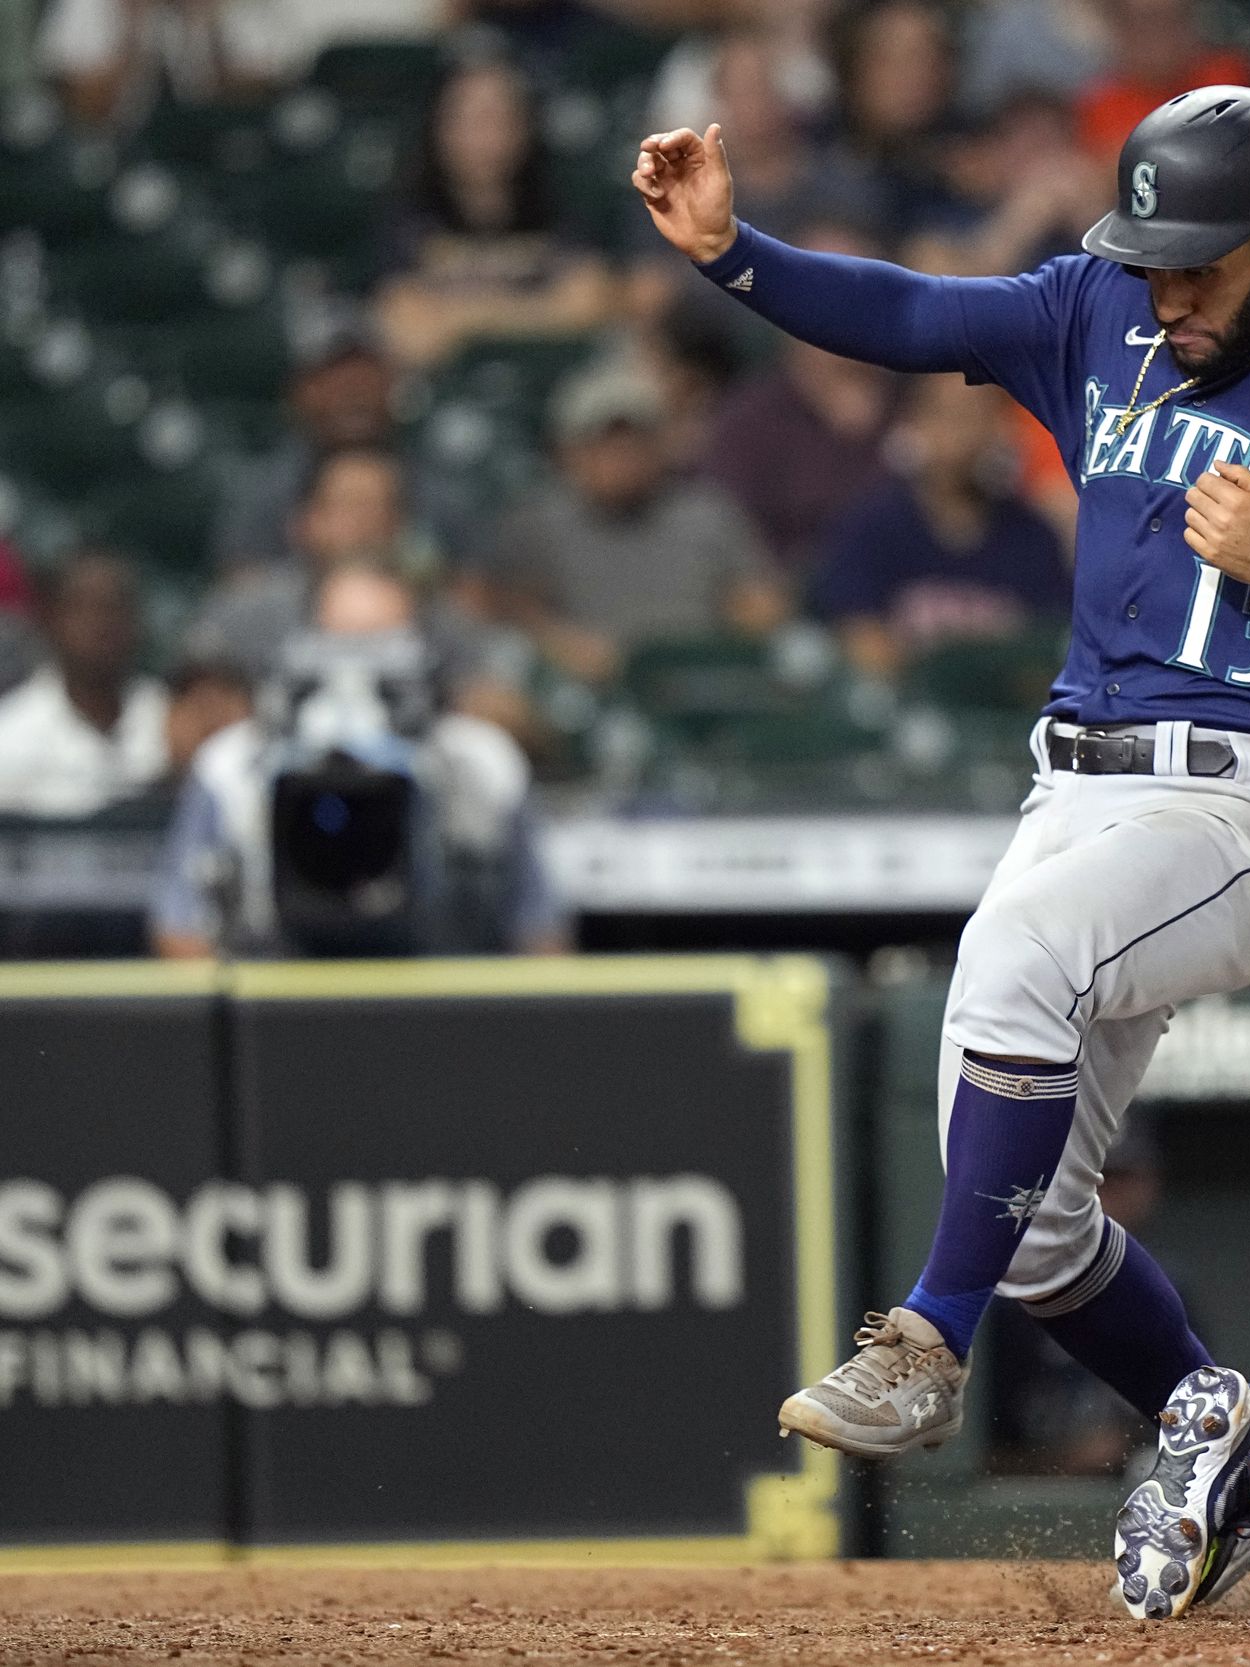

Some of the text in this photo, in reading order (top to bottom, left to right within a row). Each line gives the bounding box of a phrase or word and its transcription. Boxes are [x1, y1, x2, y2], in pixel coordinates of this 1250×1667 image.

[1132, 161, 1158, 219] S
[0, 1175, 746, 1318] securian
[0, 1328, 436, 1408] FINANCIAL
